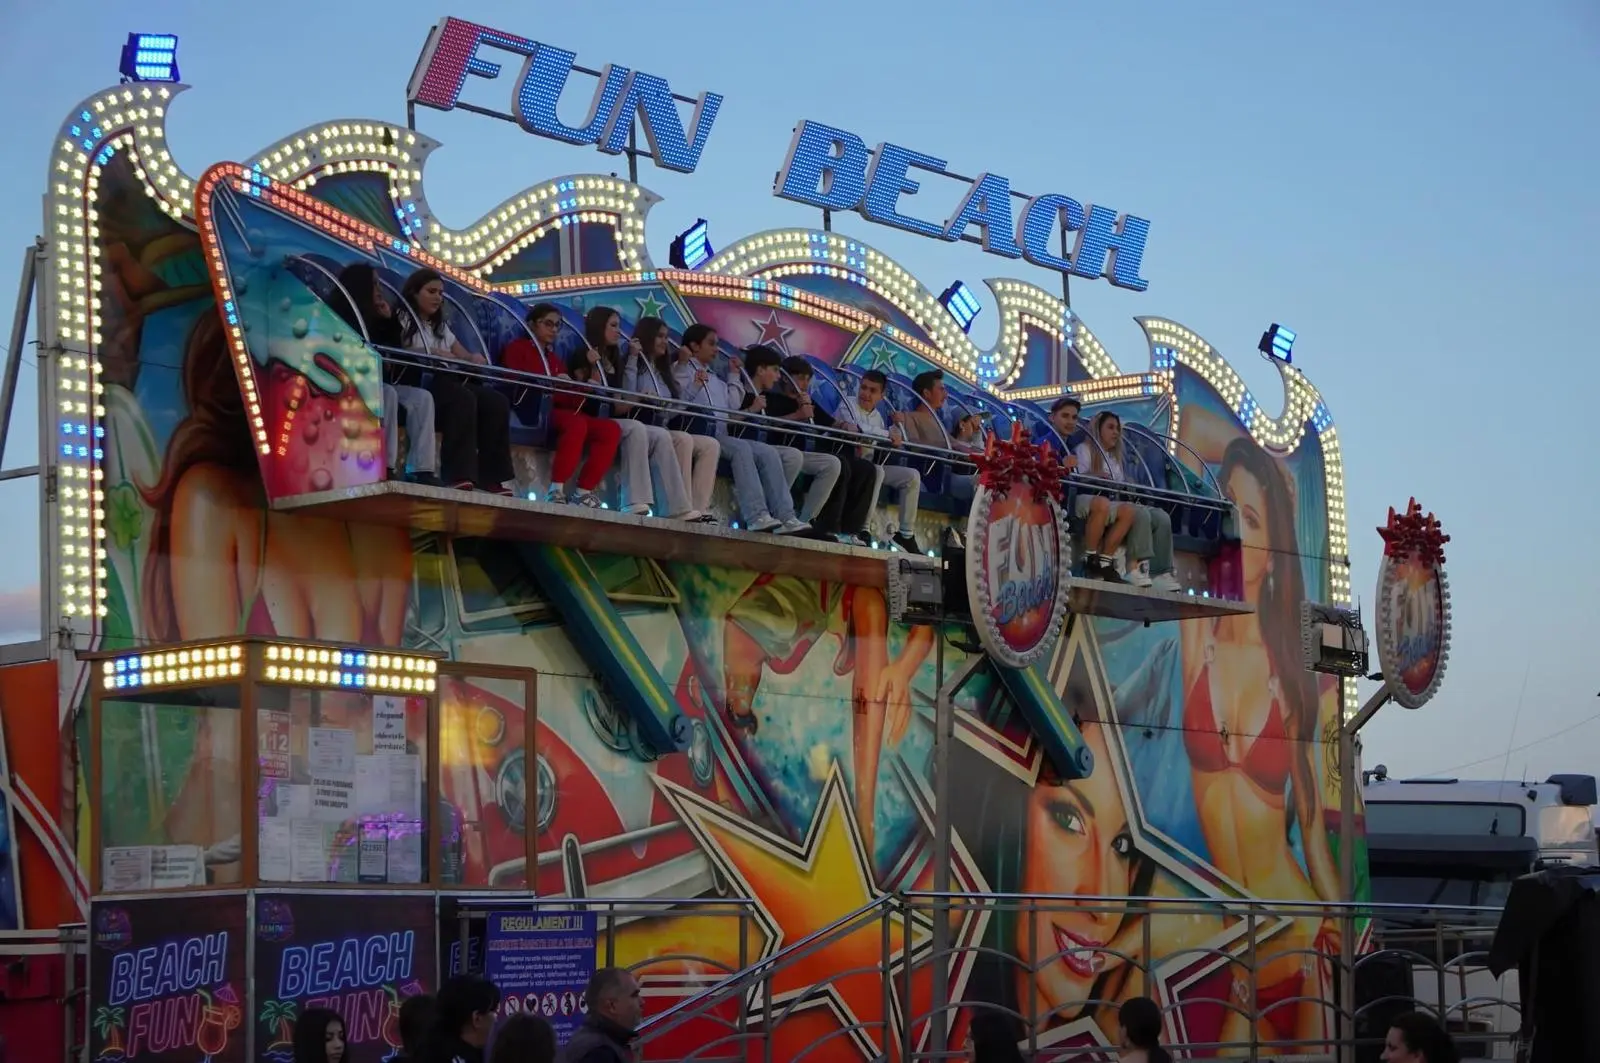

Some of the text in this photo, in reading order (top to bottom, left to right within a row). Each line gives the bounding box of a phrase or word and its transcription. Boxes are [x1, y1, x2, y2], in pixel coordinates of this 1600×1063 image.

[410, 16, 1150, 292] FUN BEACH
[988, 517, 1052, 607] FUN
[996, 556, 1052, 624] Beach
[259, 733, 288, 751] 112
[500, 915, 571, 930] REGULAMENT
[109, 931, 228, 1006] BEACH
[278, 930, 414, 1000] BEACH
[126, 993, 200, 1058] FUN
[305, 989, 385, 1043] UN
